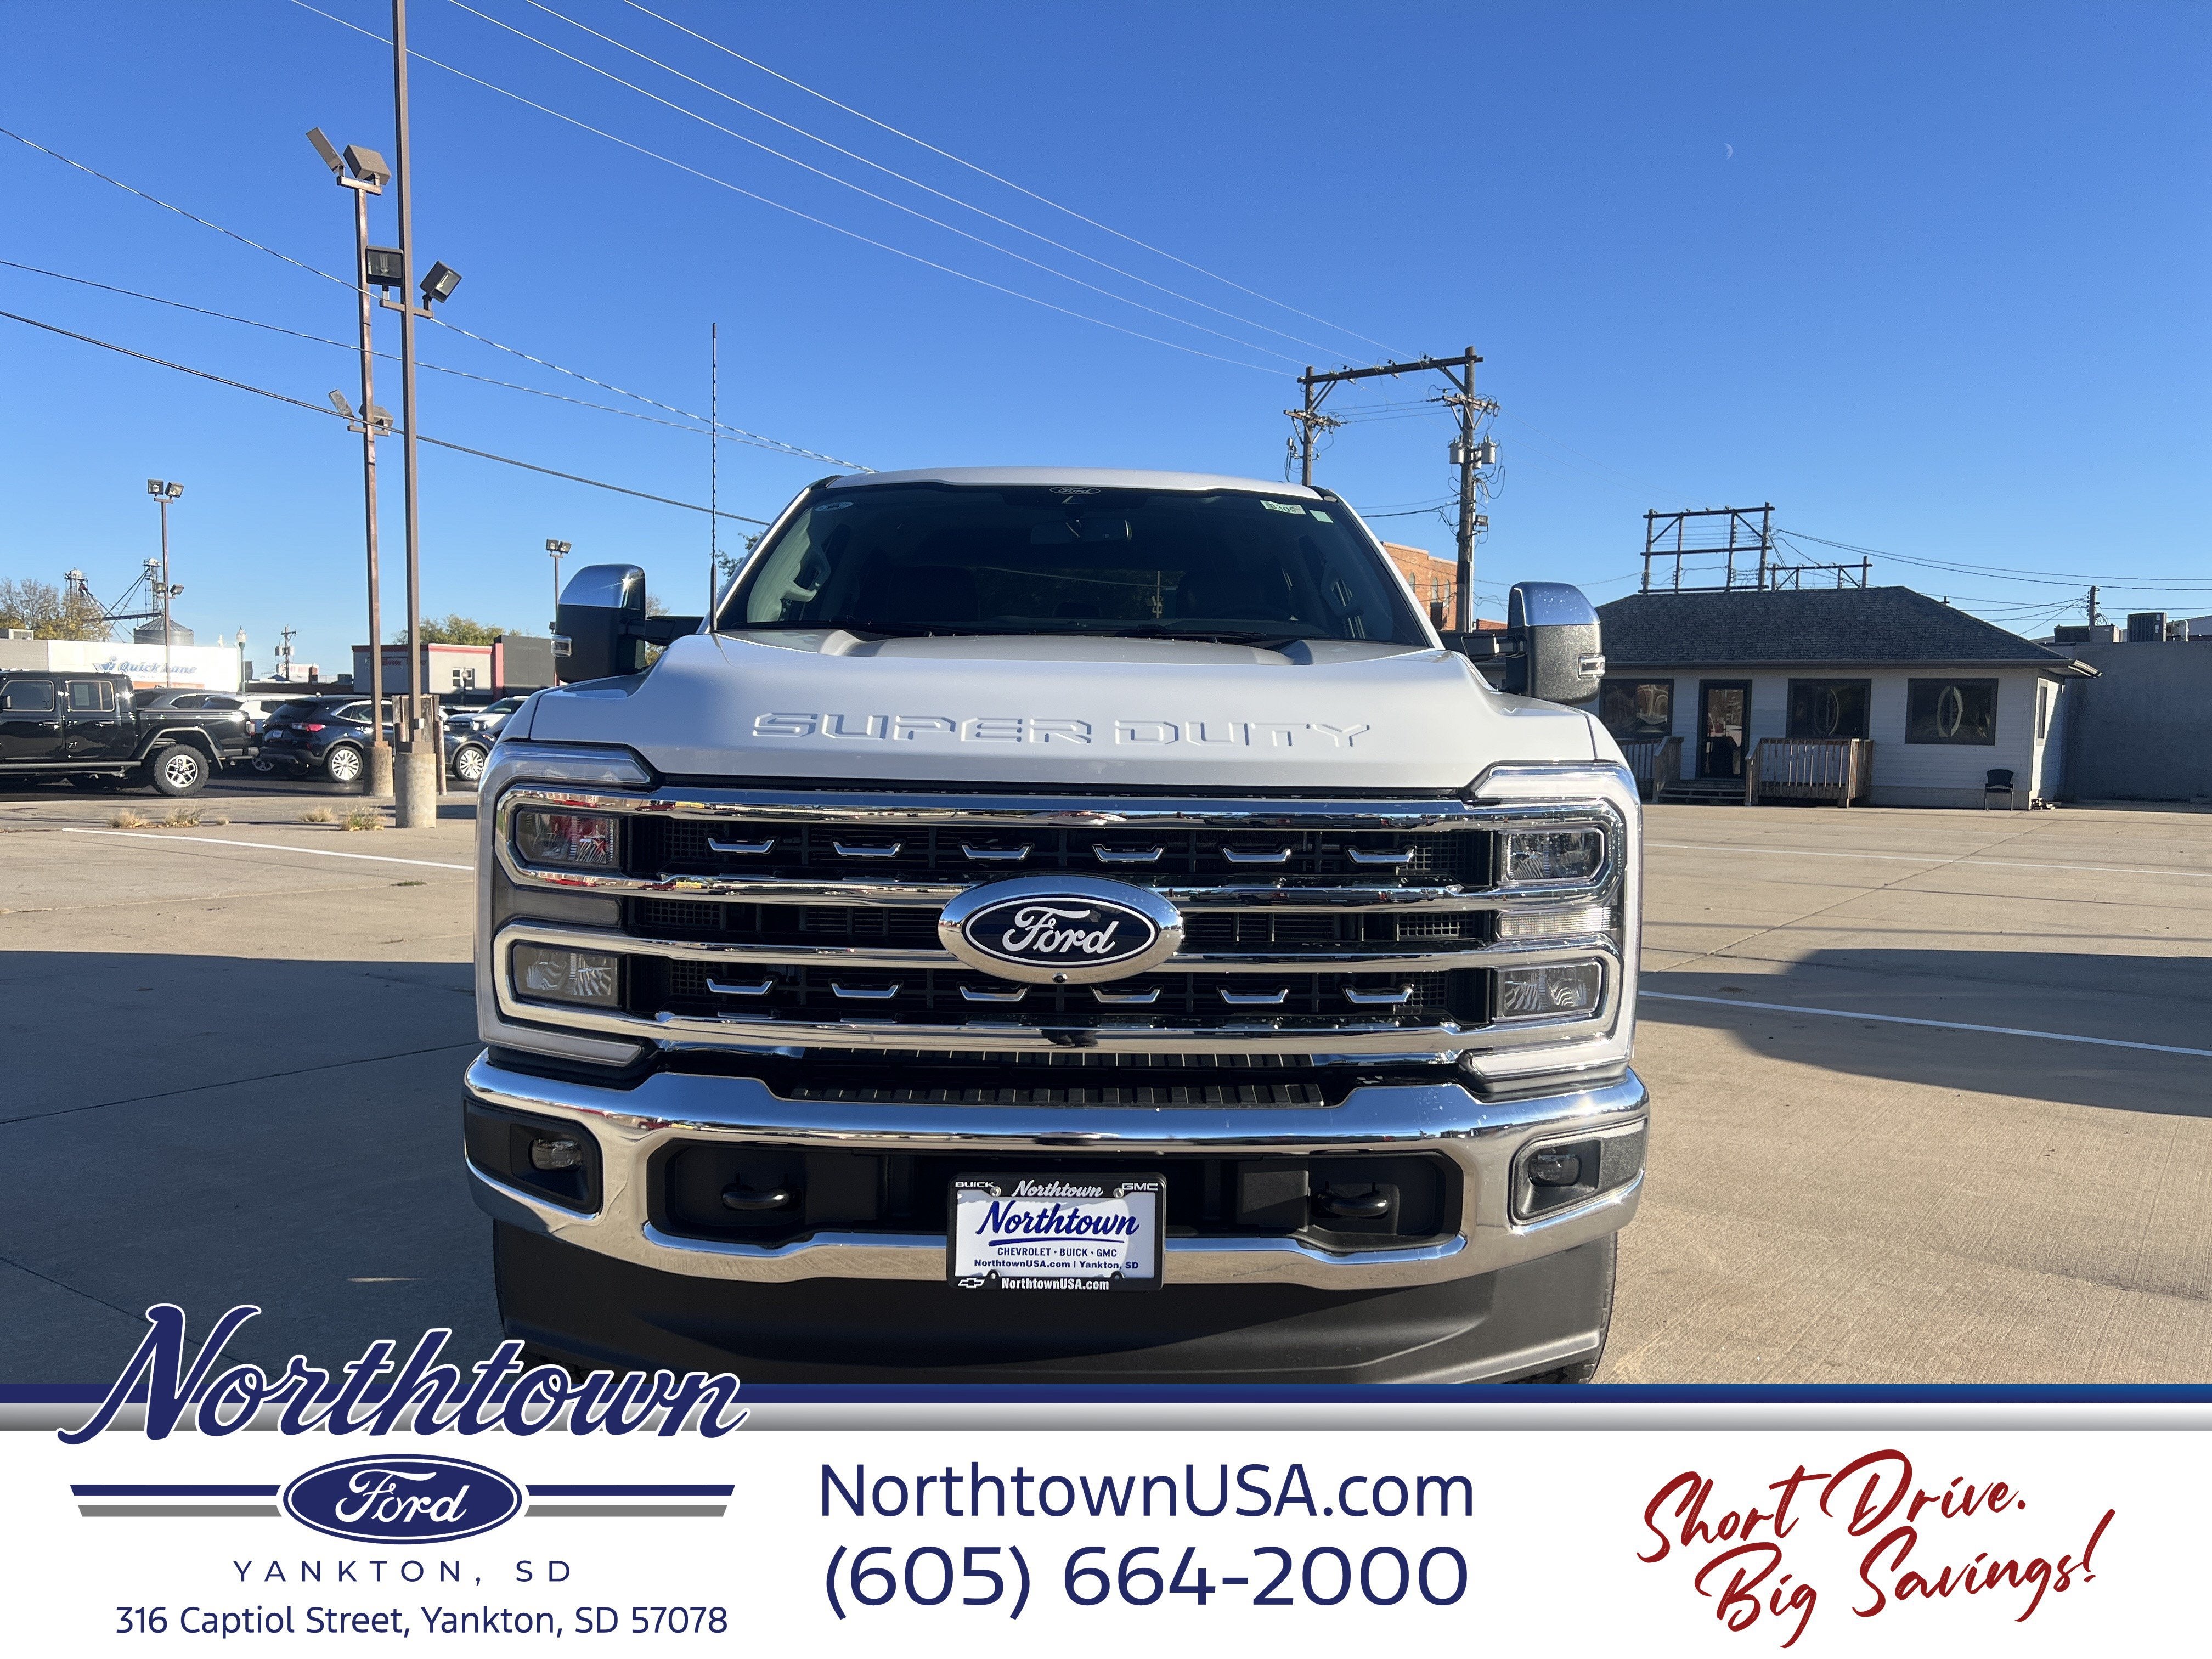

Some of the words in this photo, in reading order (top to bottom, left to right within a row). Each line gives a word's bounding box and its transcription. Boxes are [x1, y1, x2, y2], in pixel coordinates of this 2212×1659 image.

[119, 661, 158, 673] Quick
[752, 713, 1092, 744] SUPER
[1115, 720, 1370, 747] DUTY
[1002, 906, 1119, 953] Ford
[1011, 1180, 1103, 1197] Northtown
[1121, 1183, 1158, 1191] GMC
[975, 1200, 1139, 1235] Northtown
[997, 1247, 1051, 1256] CHEVROLET
[1059, 1248, 1088, 1257] BUICK
[1097, 1249, 1117, 1257] GMC
[974, 1259, 1070, 1268] NorthtownUSA.com
[1080, 1261, 1122, 1270] Yankton,
[1002, 1278, 1109, 1290] NorthtownUSA.com
